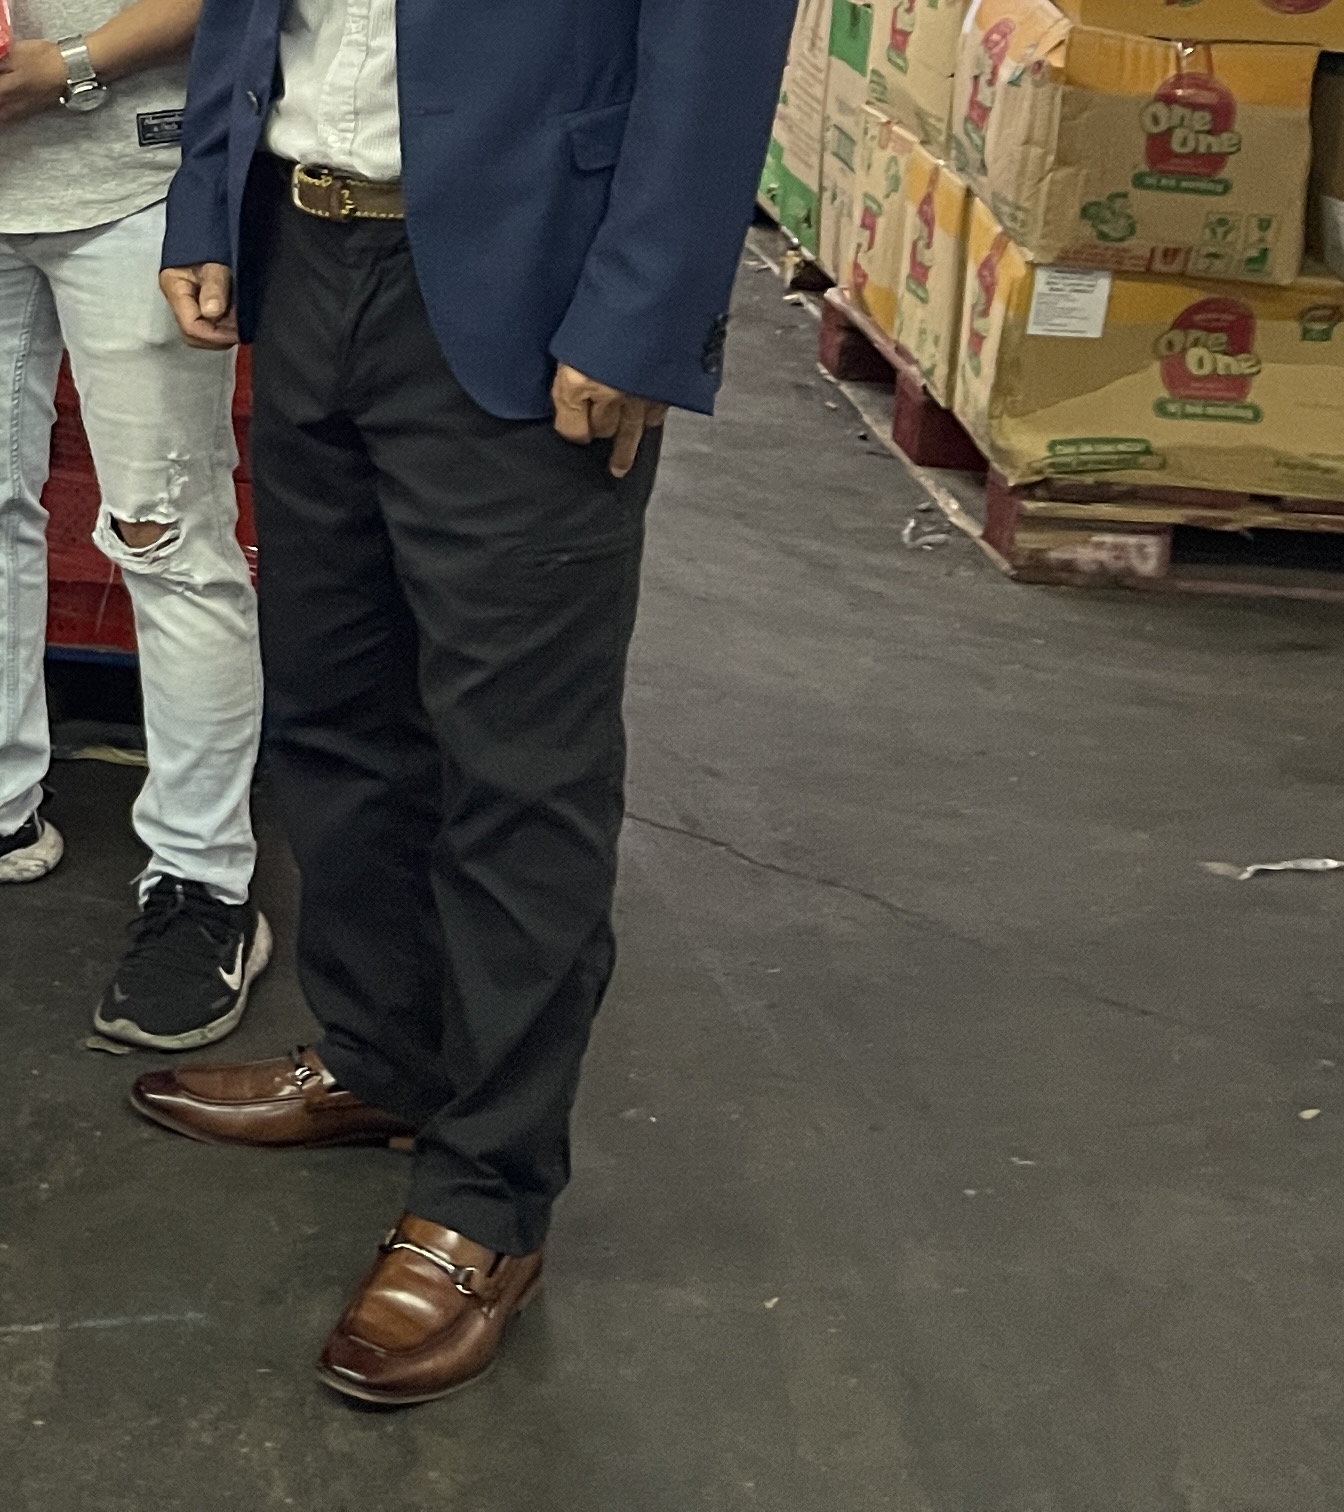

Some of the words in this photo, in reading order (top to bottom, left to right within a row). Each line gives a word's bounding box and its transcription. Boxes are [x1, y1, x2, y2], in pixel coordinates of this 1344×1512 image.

[1138, 99, 1214, 136] One
[1170, 126, 1243, 157] One
[1154, 329, 1230, 357] One
[1184, 345, 1263, 377] One
